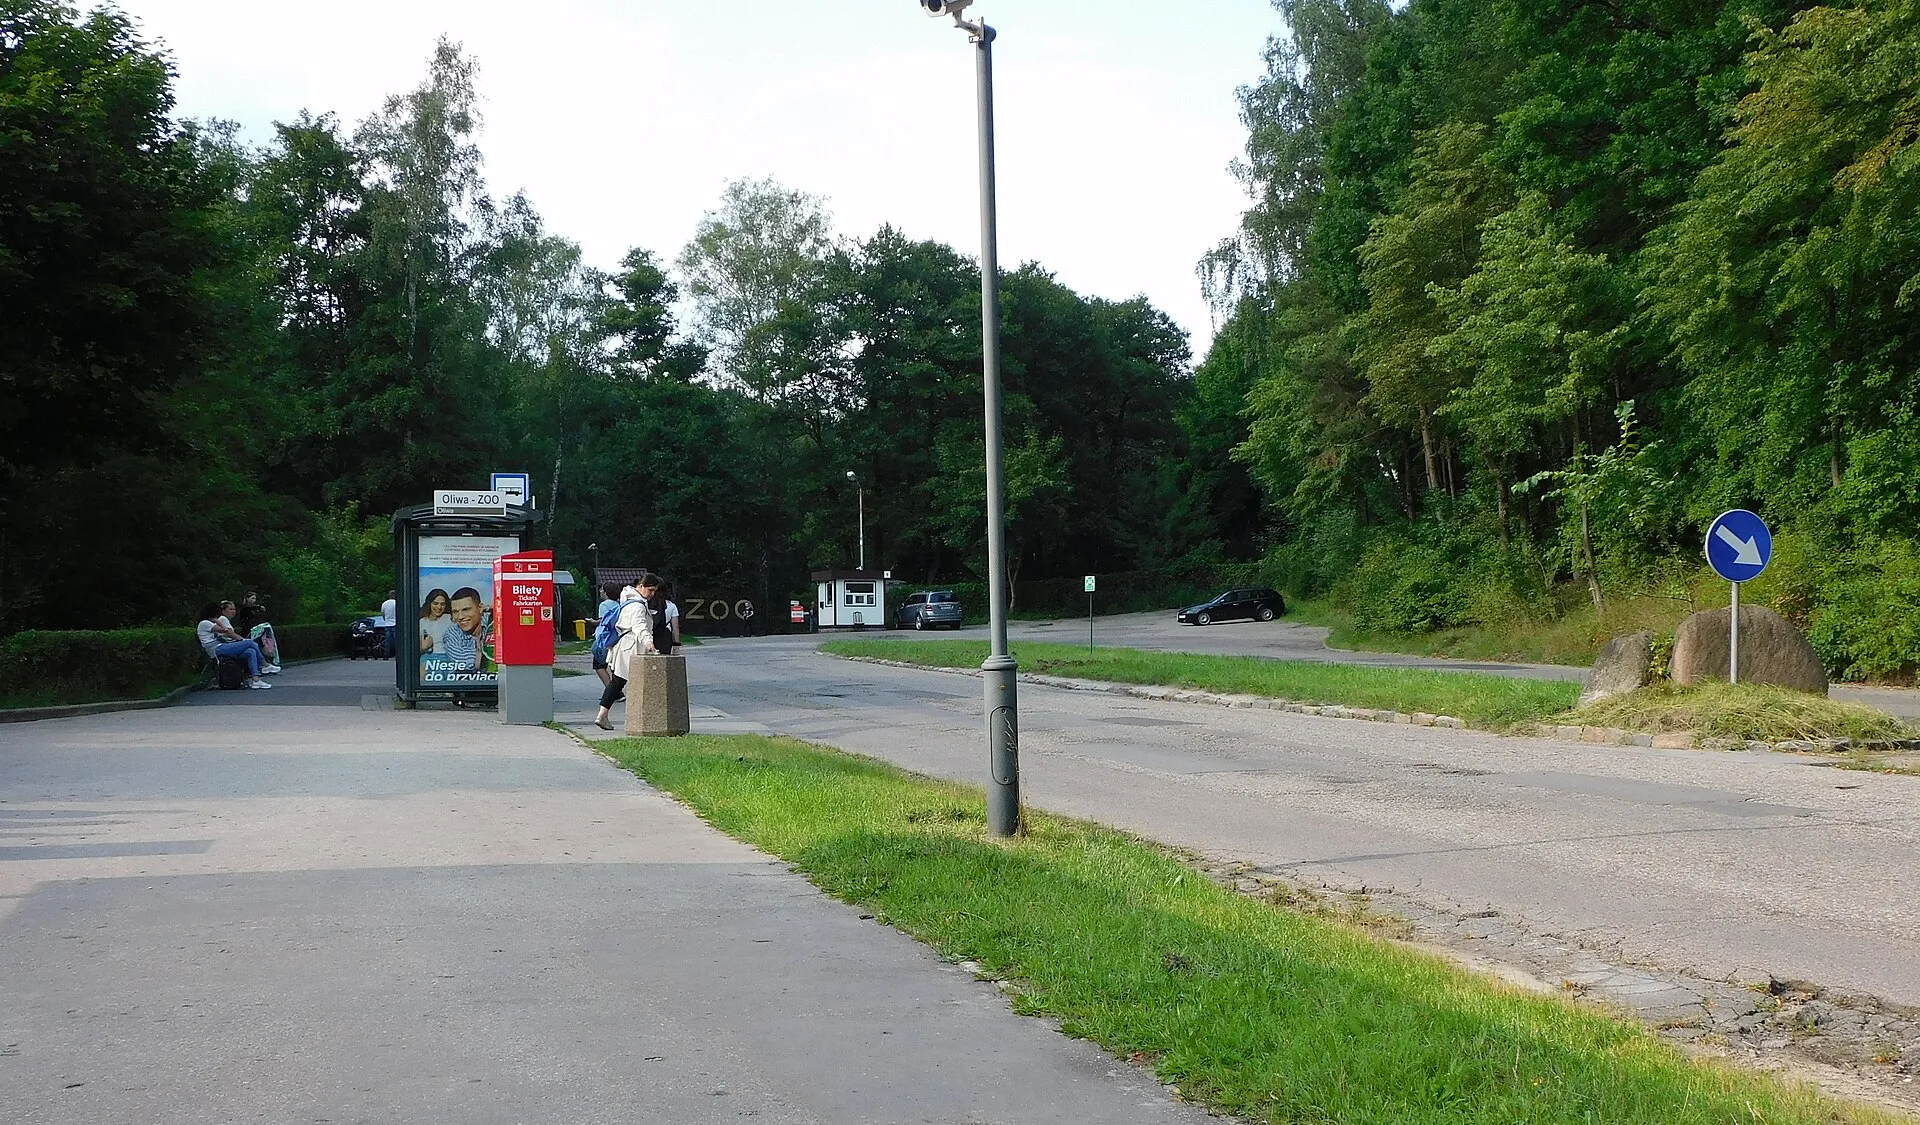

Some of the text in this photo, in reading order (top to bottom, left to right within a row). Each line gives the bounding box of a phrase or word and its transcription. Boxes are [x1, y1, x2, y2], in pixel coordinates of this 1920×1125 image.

[442, 494, 469, 504] Oliwa
[477, 494, 500, 504] ZOO
[512, 585, 543, 597] Bilety
[684, 598, 755, 620] ZOO
[424, 659, 467, 671] Niesie
[424, 671, 444, 681] do
